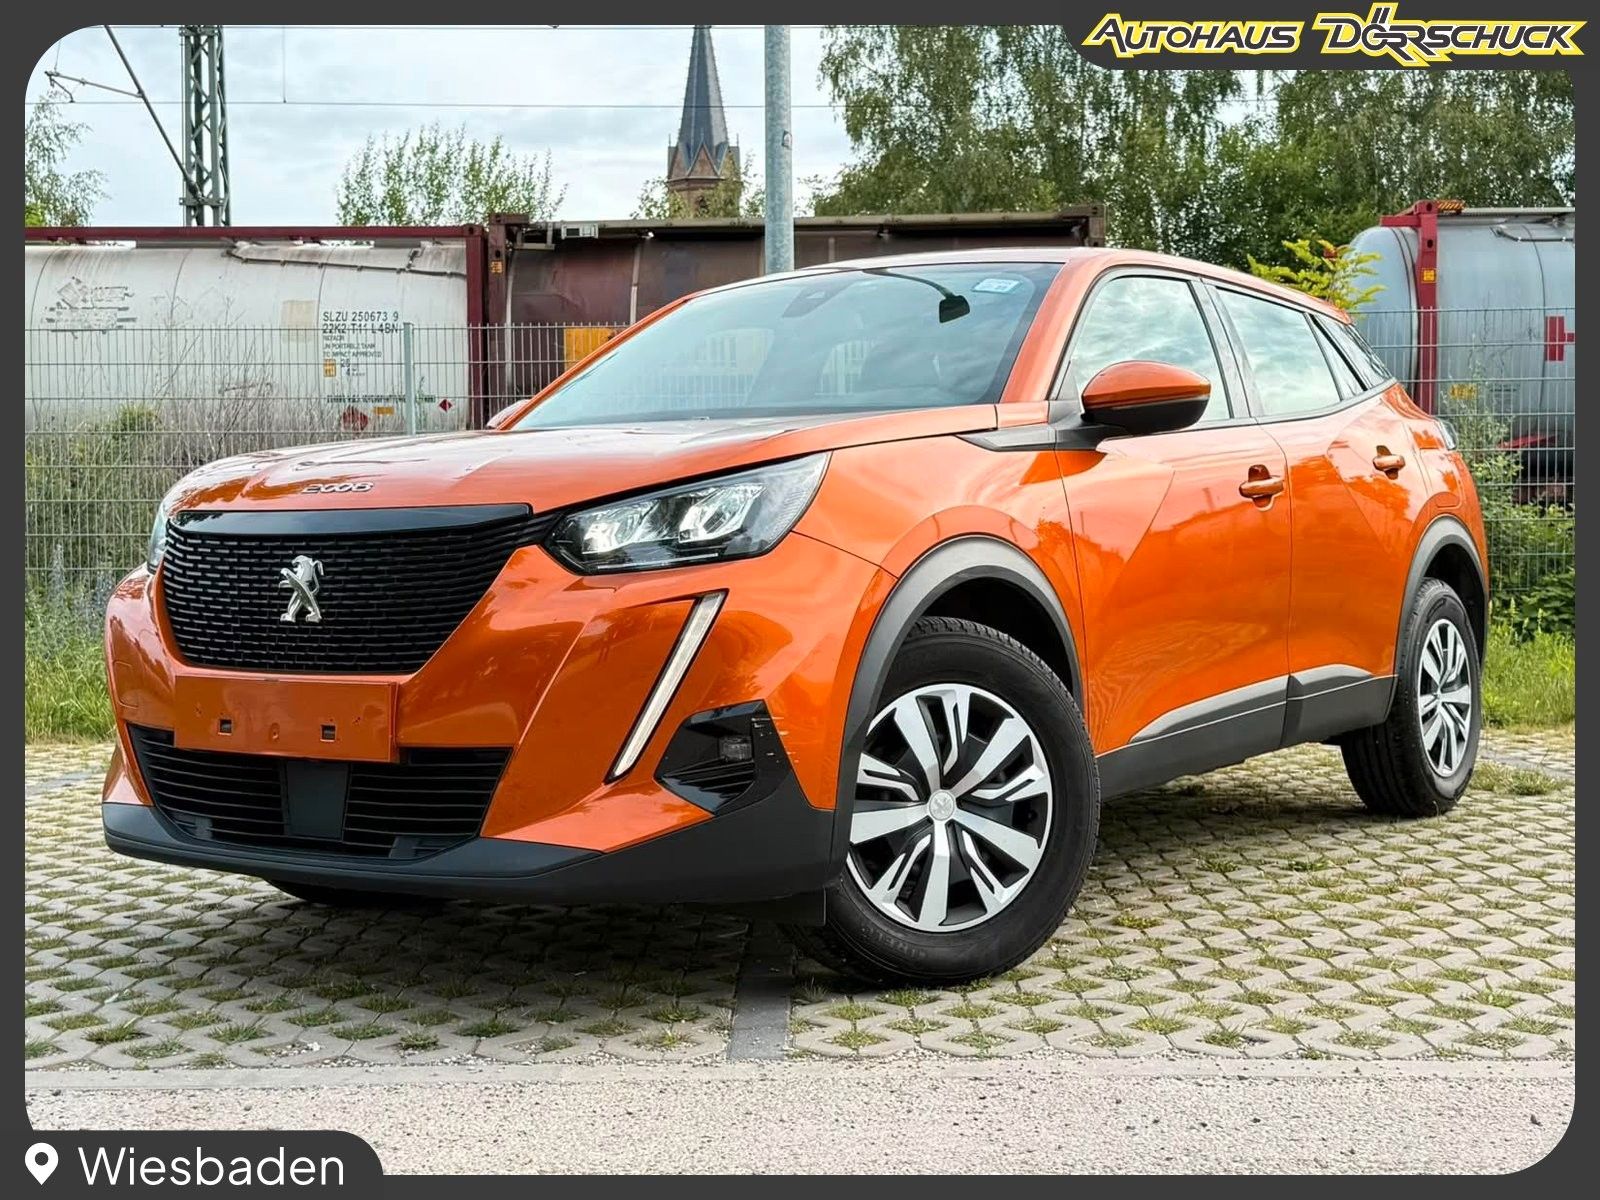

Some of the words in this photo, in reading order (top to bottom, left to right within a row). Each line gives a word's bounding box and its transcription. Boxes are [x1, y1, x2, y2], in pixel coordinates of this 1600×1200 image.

[322, 311, 348, 322] SLZU
[351, 311, 388, 322] 250673
[392, 311, 399, 322] 9
[322, 322, 347, 334] 22K2
